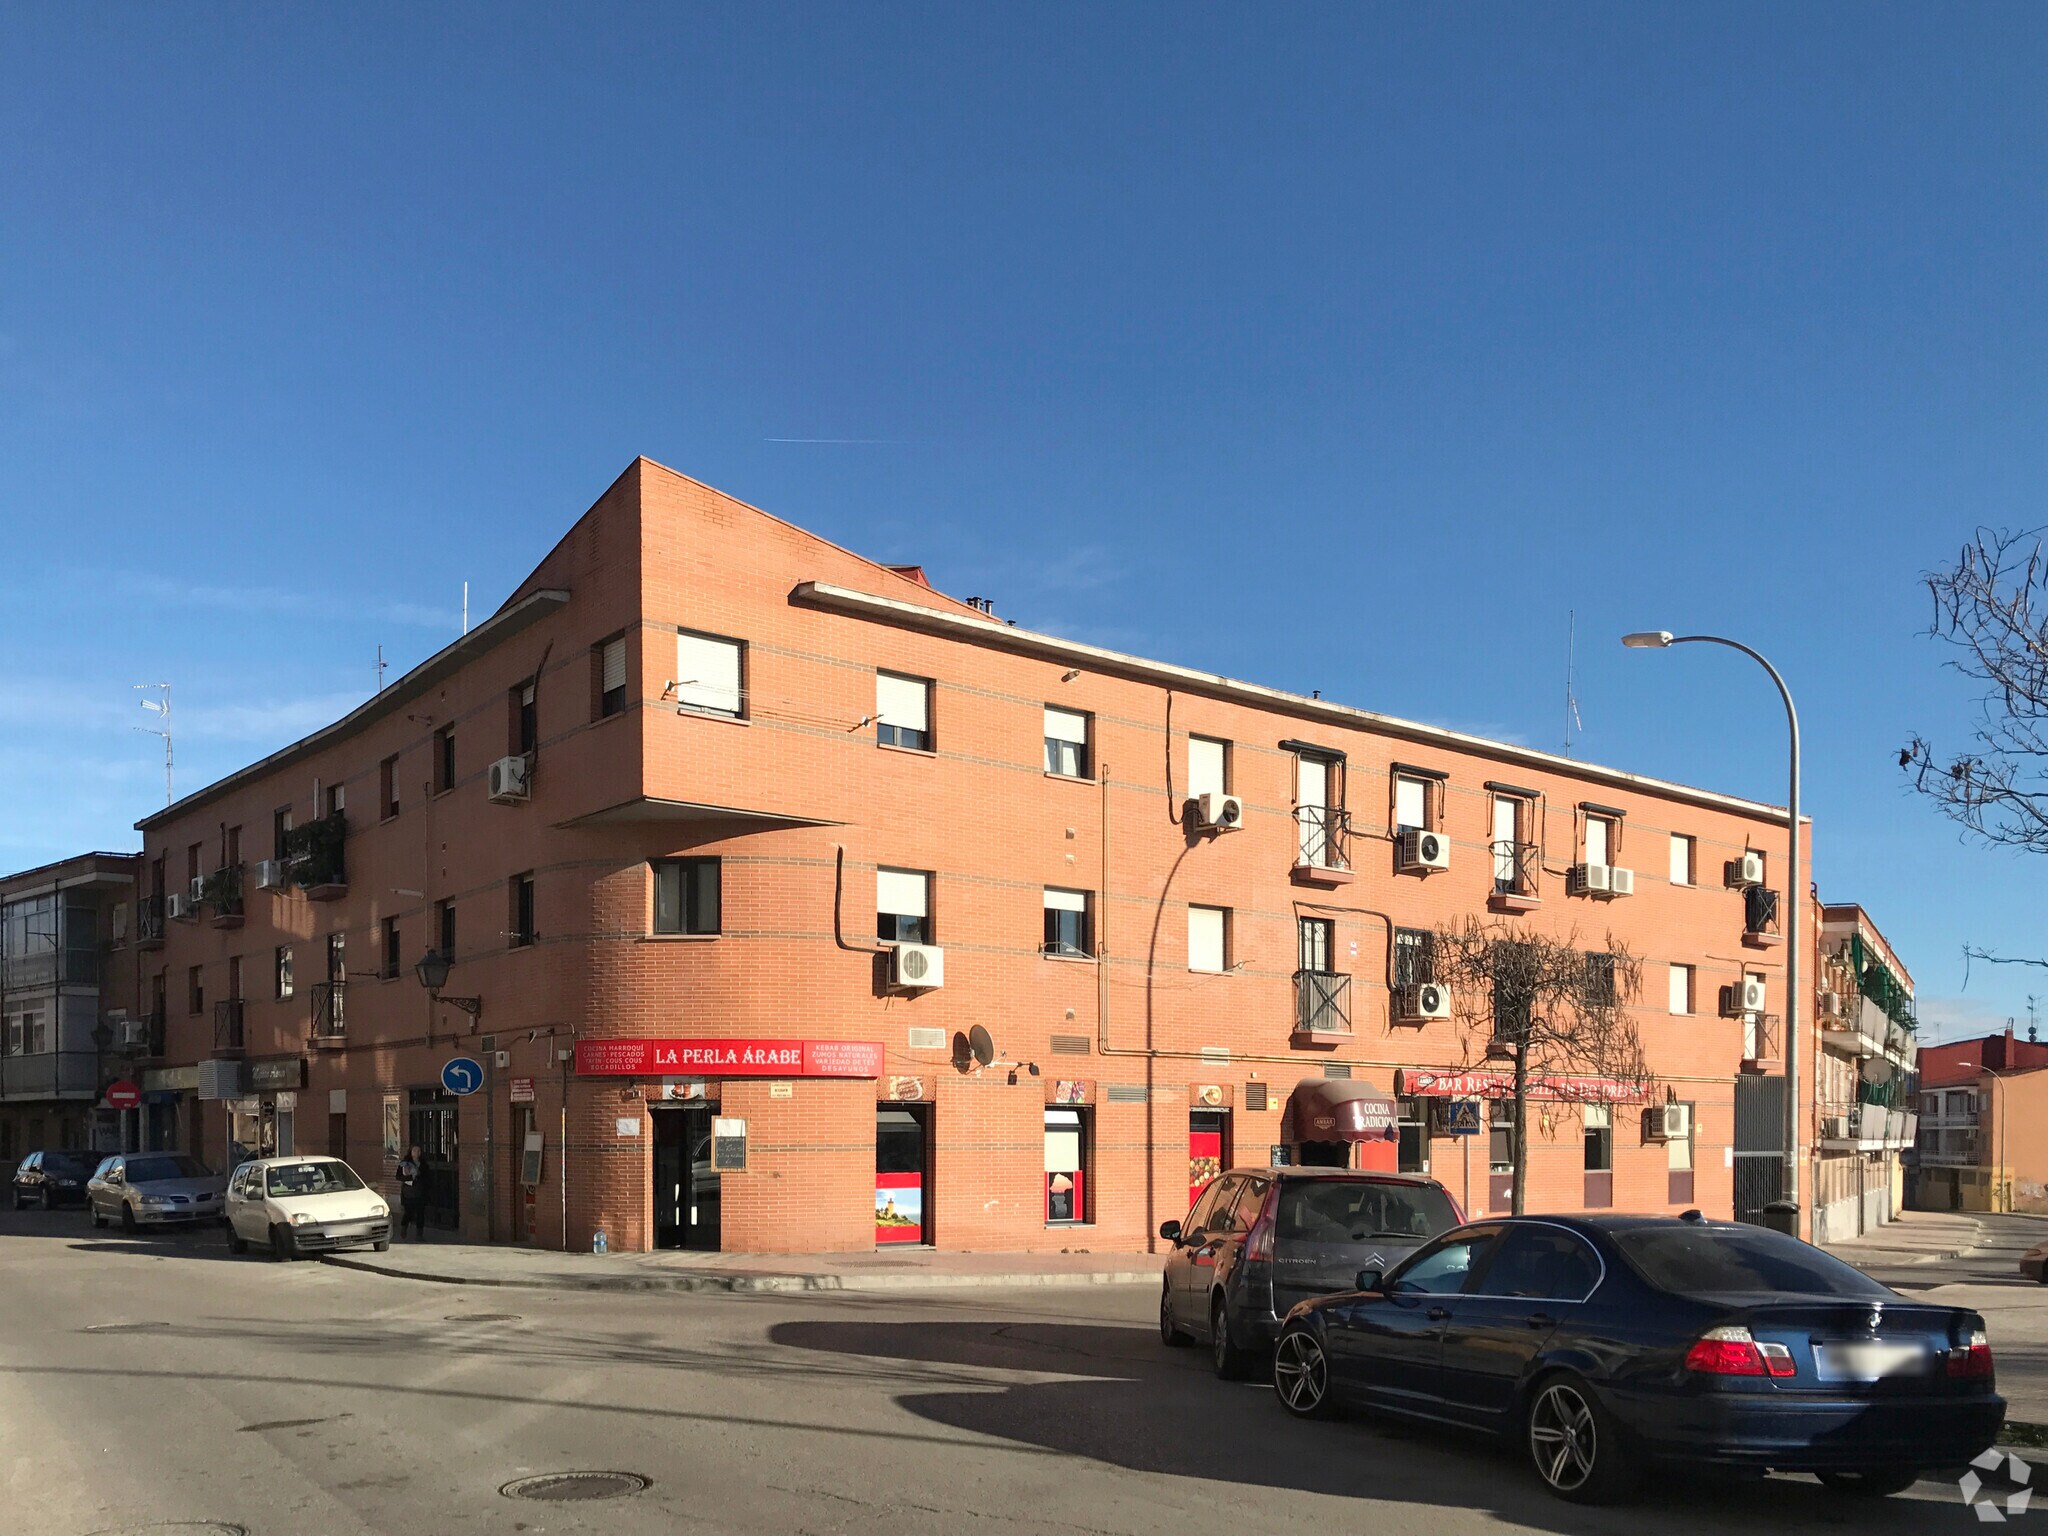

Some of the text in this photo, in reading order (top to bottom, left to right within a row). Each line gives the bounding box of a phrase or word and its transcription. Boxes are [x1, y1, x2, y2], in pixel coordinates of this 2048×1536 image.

[609, 1043, 644, 1052] MARROQUÍ
[655, 1045, 801, 1065] LA PERLA ÁRABE
[1438, 1077, 1462, 1091] BAR
[1364, 1102, 1390, 1114] COCINA
